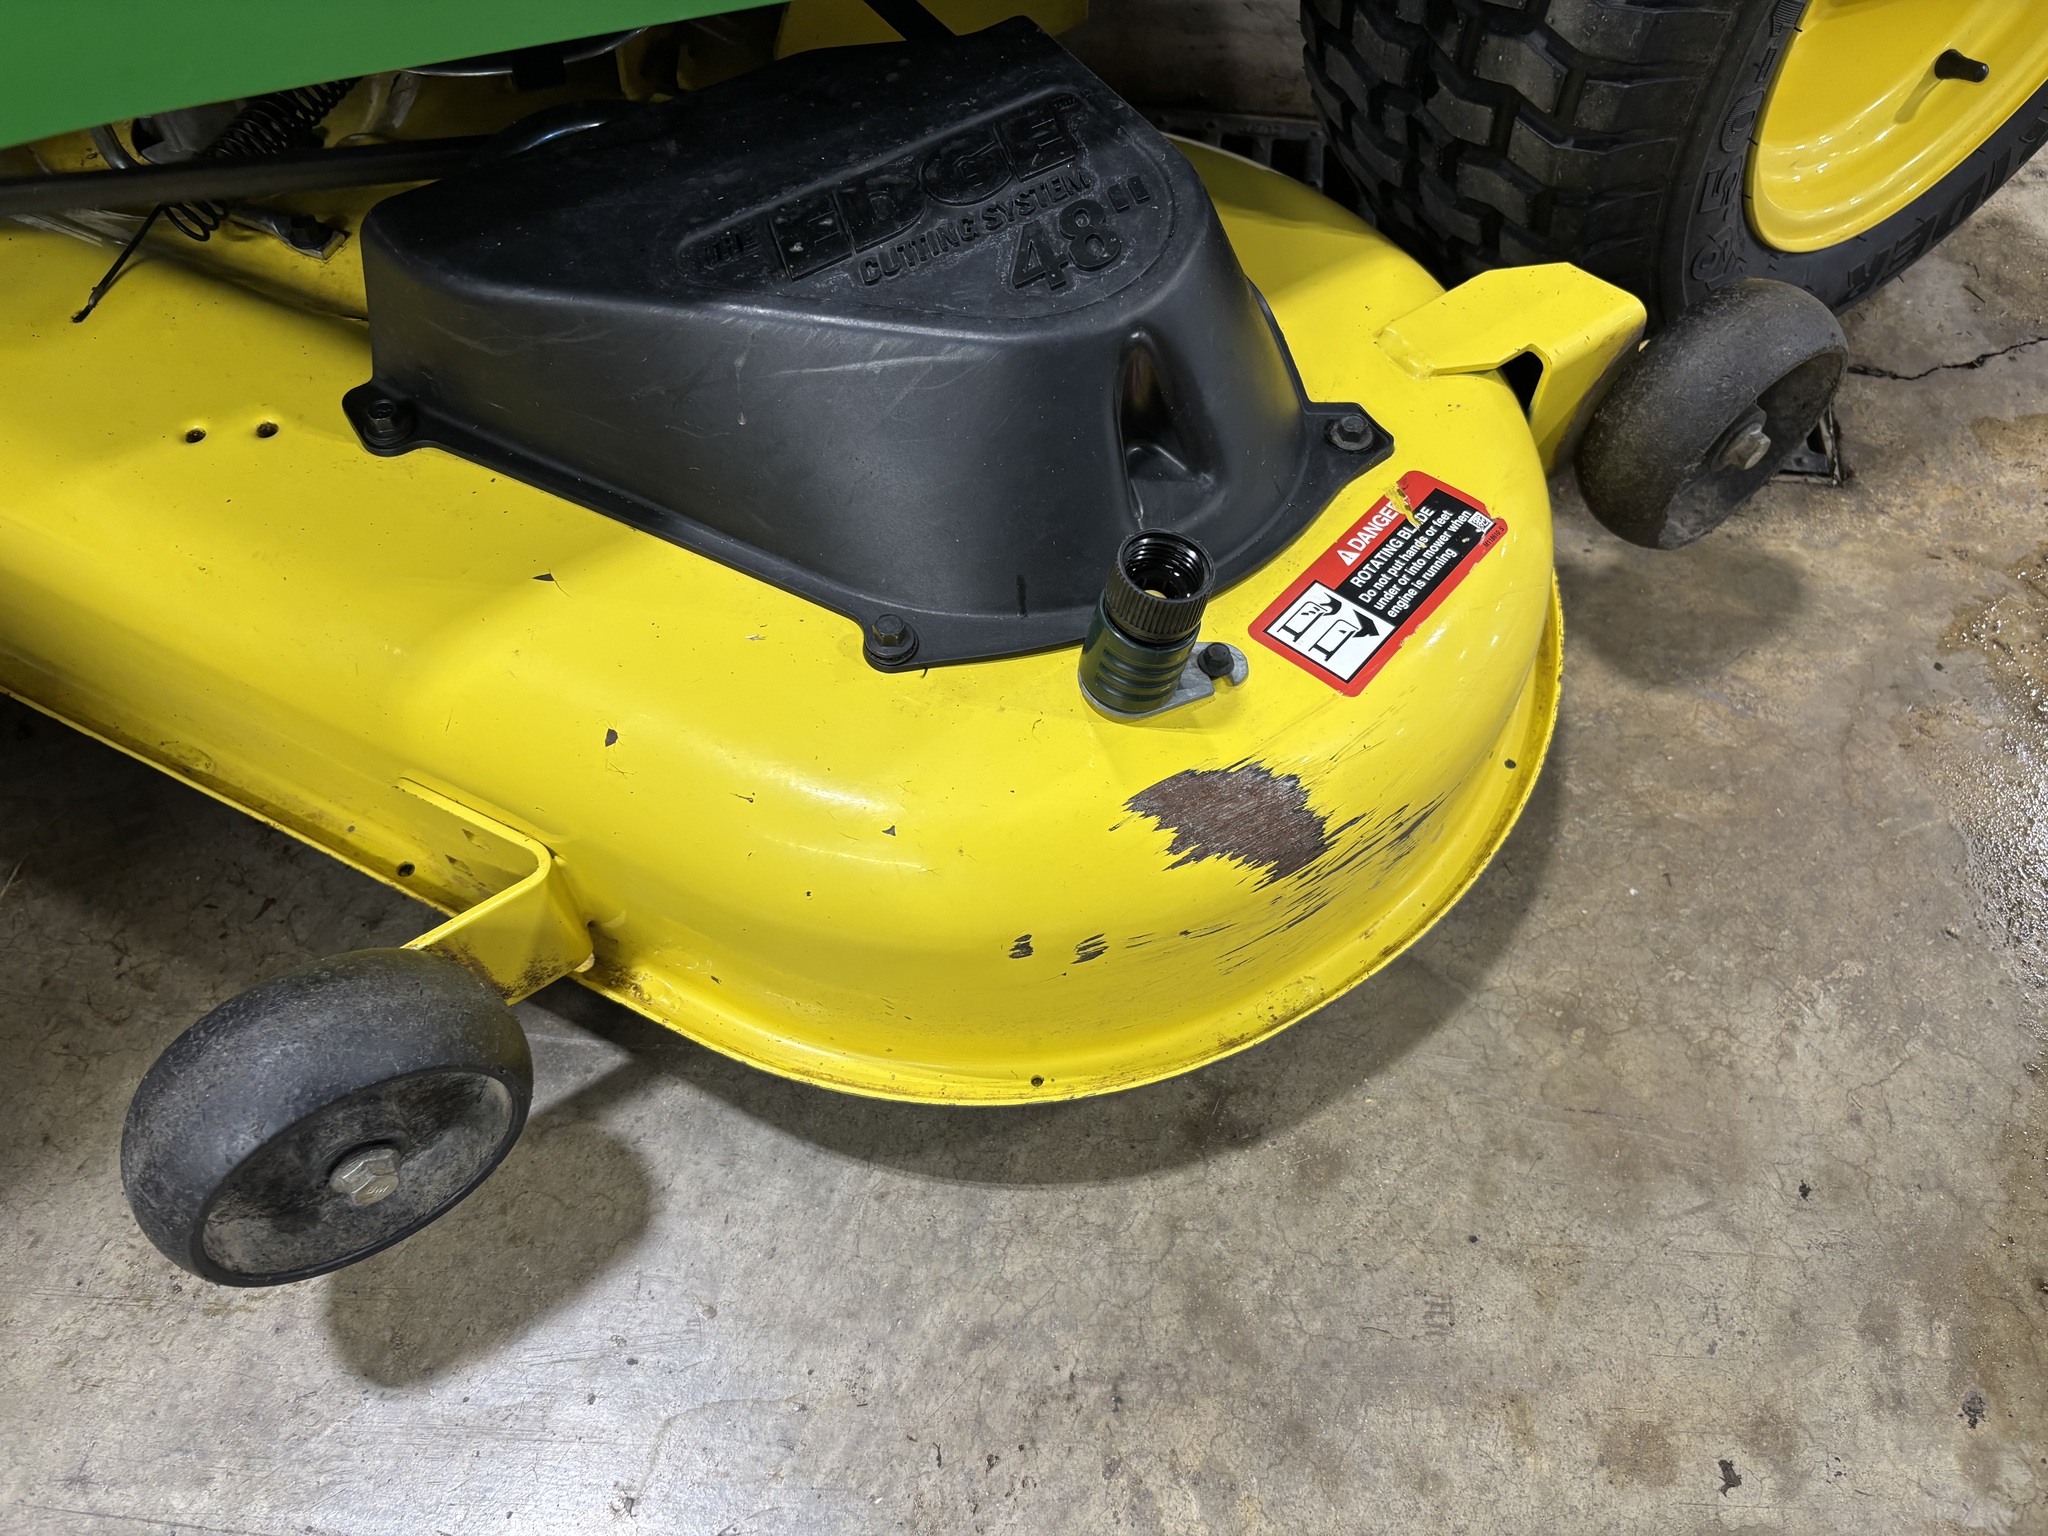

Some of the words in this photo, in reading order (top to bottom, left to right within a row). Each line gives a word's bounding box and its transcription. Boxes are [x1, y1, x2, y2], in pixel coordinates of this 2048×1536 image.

[701, 222, 758, 266] THE
[765, 104, 1076, 282] EDGE
[858, 217, 979, 286] CUTTING
[981, 170, 1090, 231] SYSTEM
[1422, 530, 1452, 559] mower
[1446, 510, 1472, 532] when
[1349, 537, 1404, 588] ROTATING
[1396, 505, 1435, 540] BLDE
[1357, 588, 1377, 603] Do
[1372, 573, 1392, 590] not
[1386, 559, 1407, 577] put
[1398, 535, 1429, 562] hands
[1424, 525, 1438, 536] or
[1431, 509, 1453, 527] feet
[1403, 558, 1427, 576] into
[1373, 583, 1401, 610] under
[1386, 588, 1418, 618] engine
[1410, 579, 1426, 590] is
[1421, 547, 1458, 581] running
[1396, 573, 1411, 585] or
